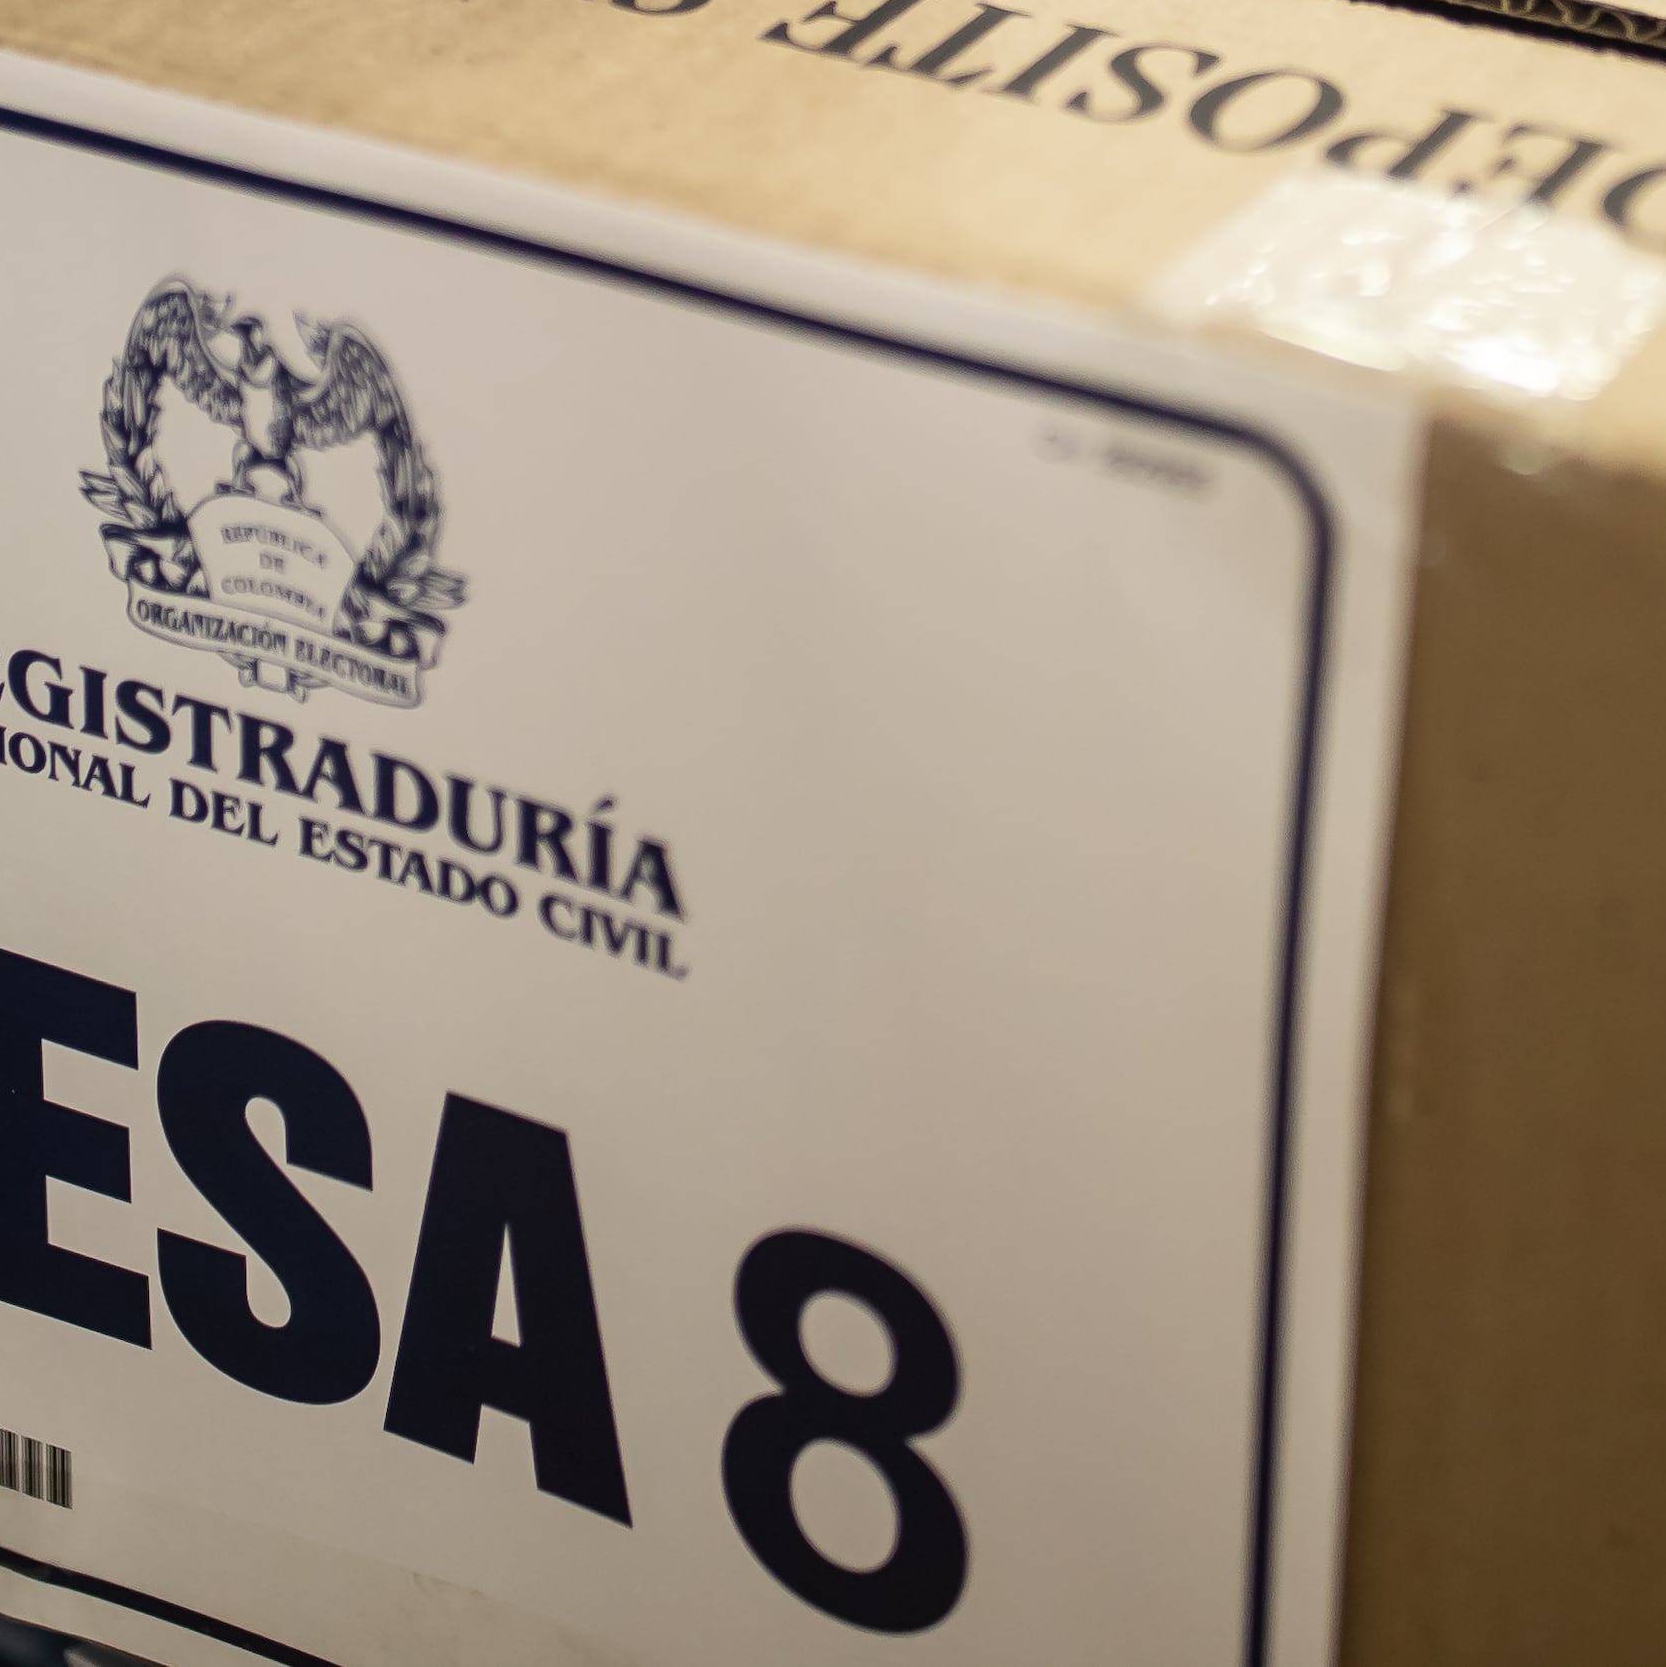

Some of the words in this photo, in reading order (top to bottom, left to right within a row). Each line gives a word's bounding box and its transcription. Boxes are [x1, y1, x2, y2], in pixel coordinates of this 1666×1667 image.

[167, 778, 280, 848] DEL
[296, 816, 519, 920] ESTADO
[536, 890, 691, 981] CIVIL
[720, 1225, 971, 1637] 8
